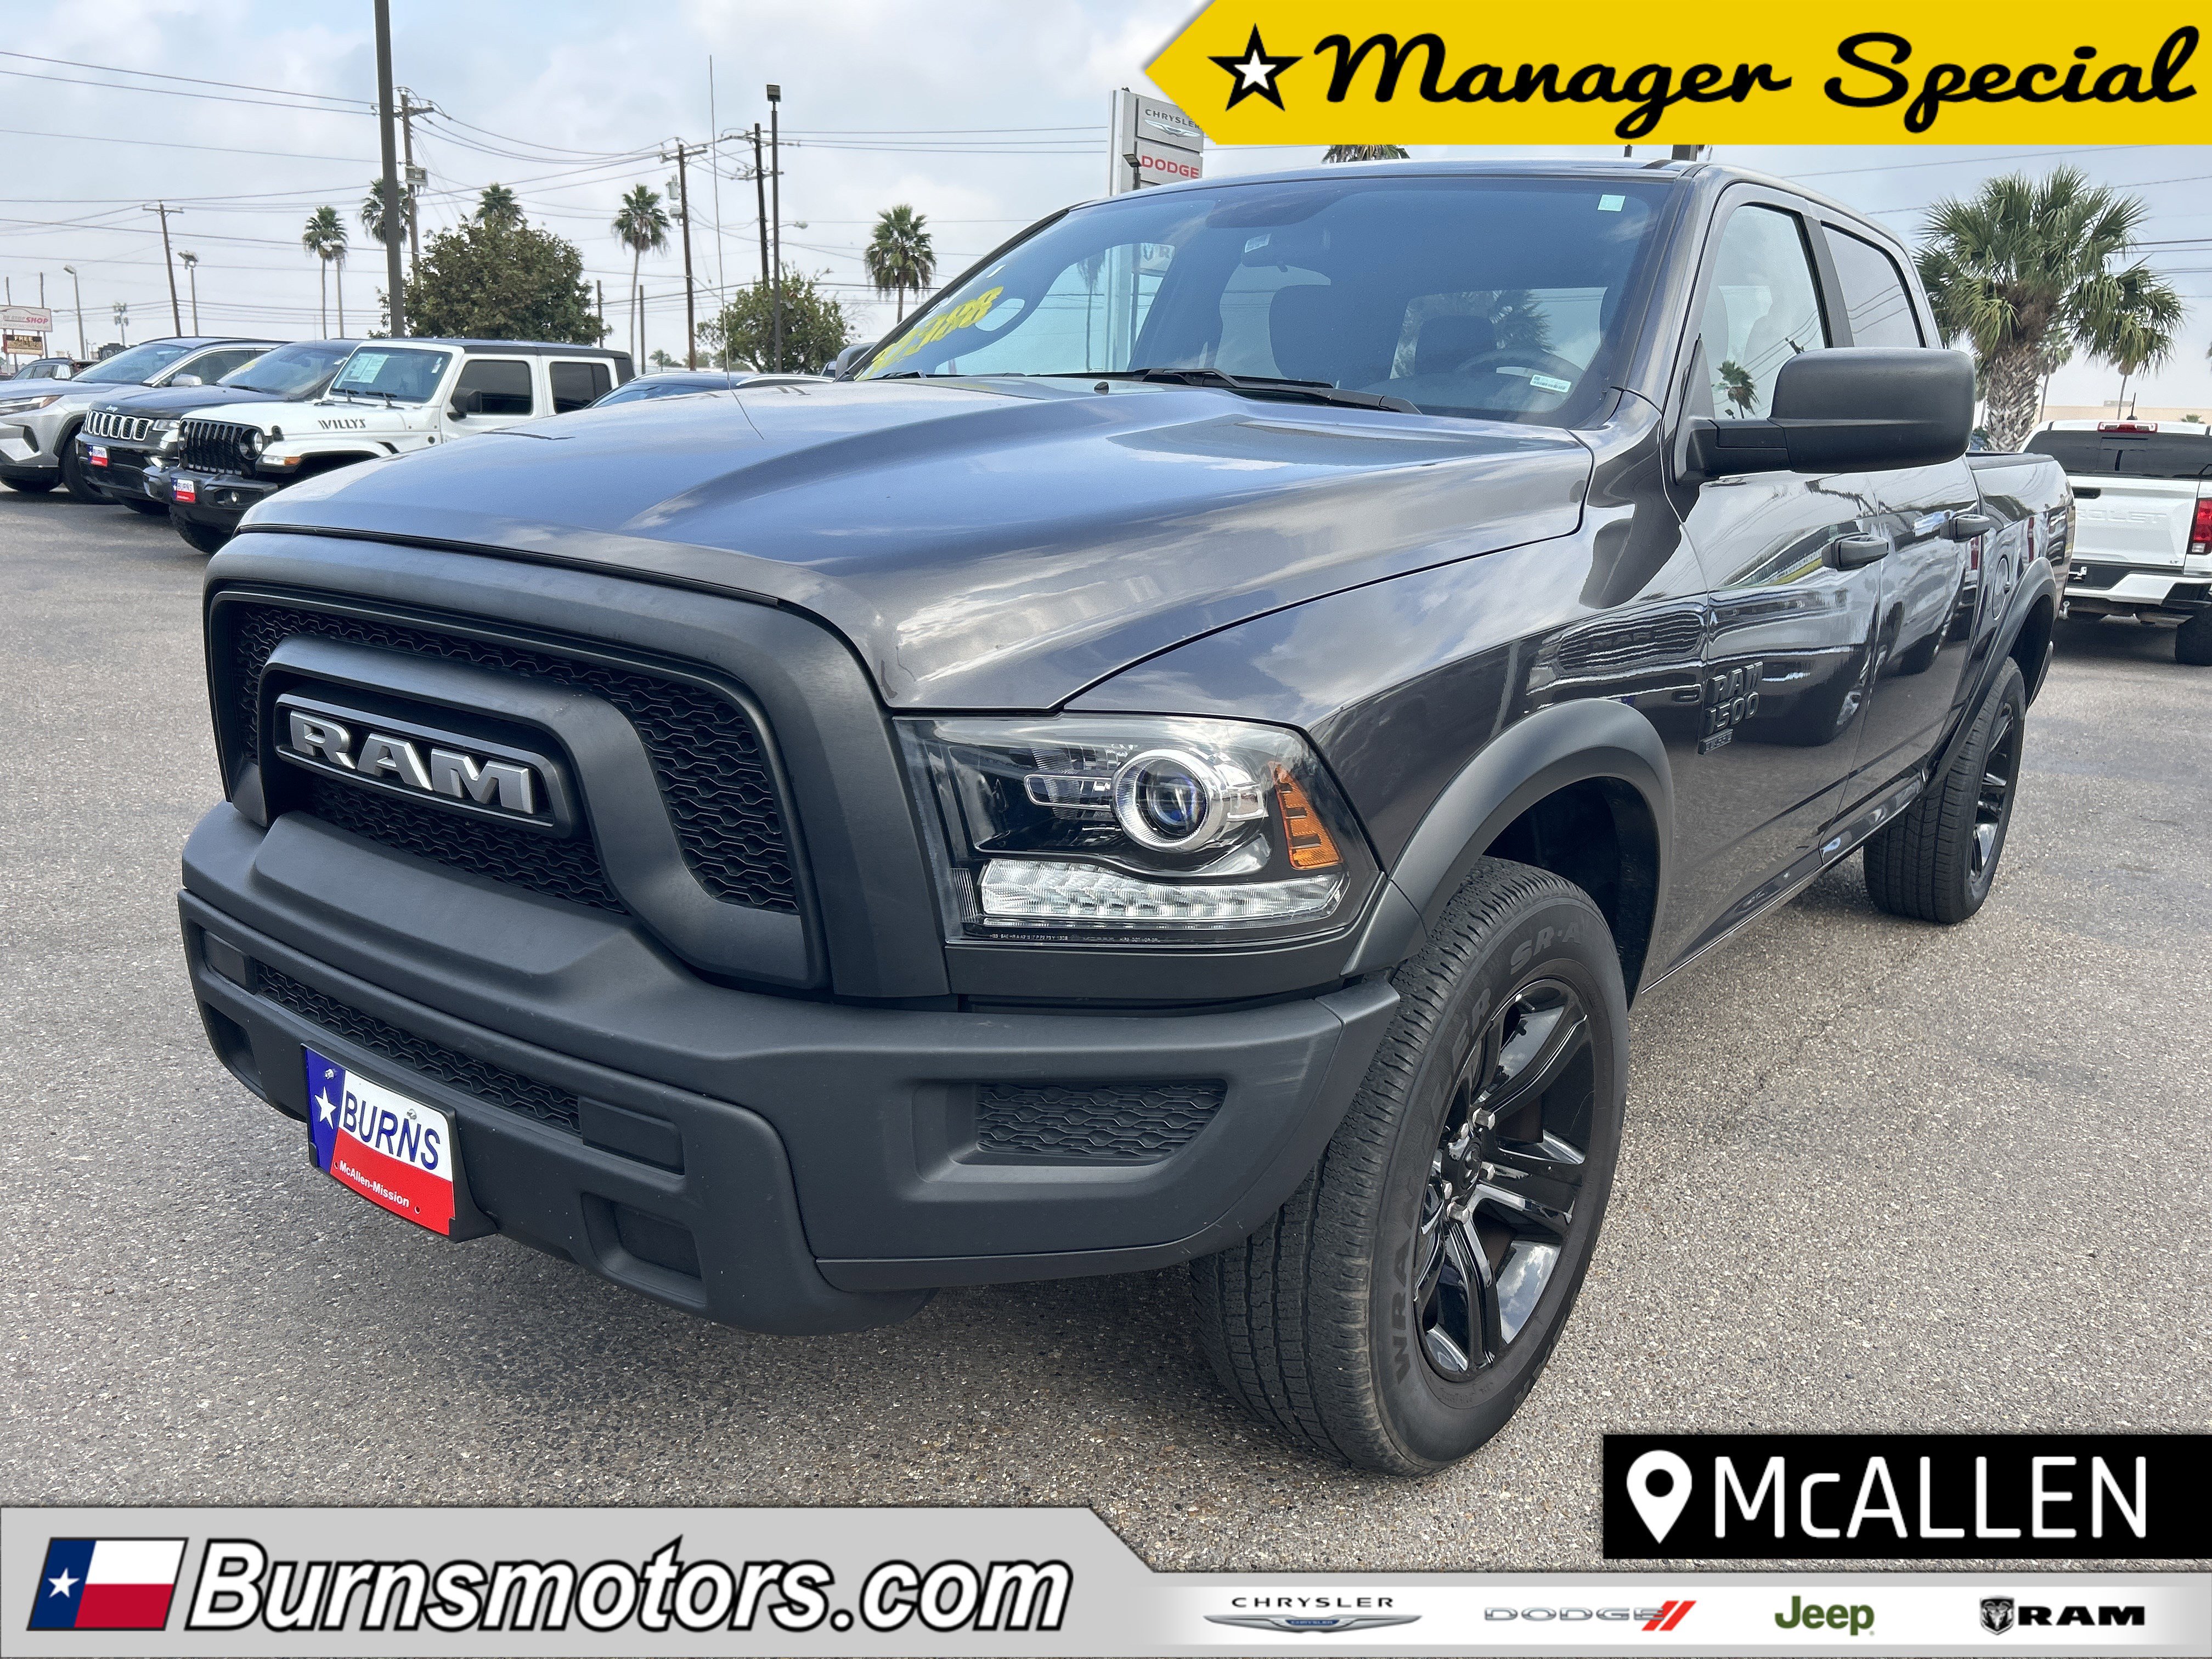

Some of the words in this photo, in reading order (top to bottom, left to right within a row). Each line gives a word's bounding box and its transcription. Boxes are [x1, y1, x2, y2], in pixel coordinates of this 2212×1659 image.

[1142, 155, 1199, 179] DODGE
[318, 419, 366, 429] WILLYS
[1705, 661, 1763, 703] RAM
[1703, 691, 1759, 734] 1500
[290, 710, 534, 814] RAM
[343, 1090, 441, 1170] BURNS
[339, 1159, 410, 1209] McAllen-Mission
